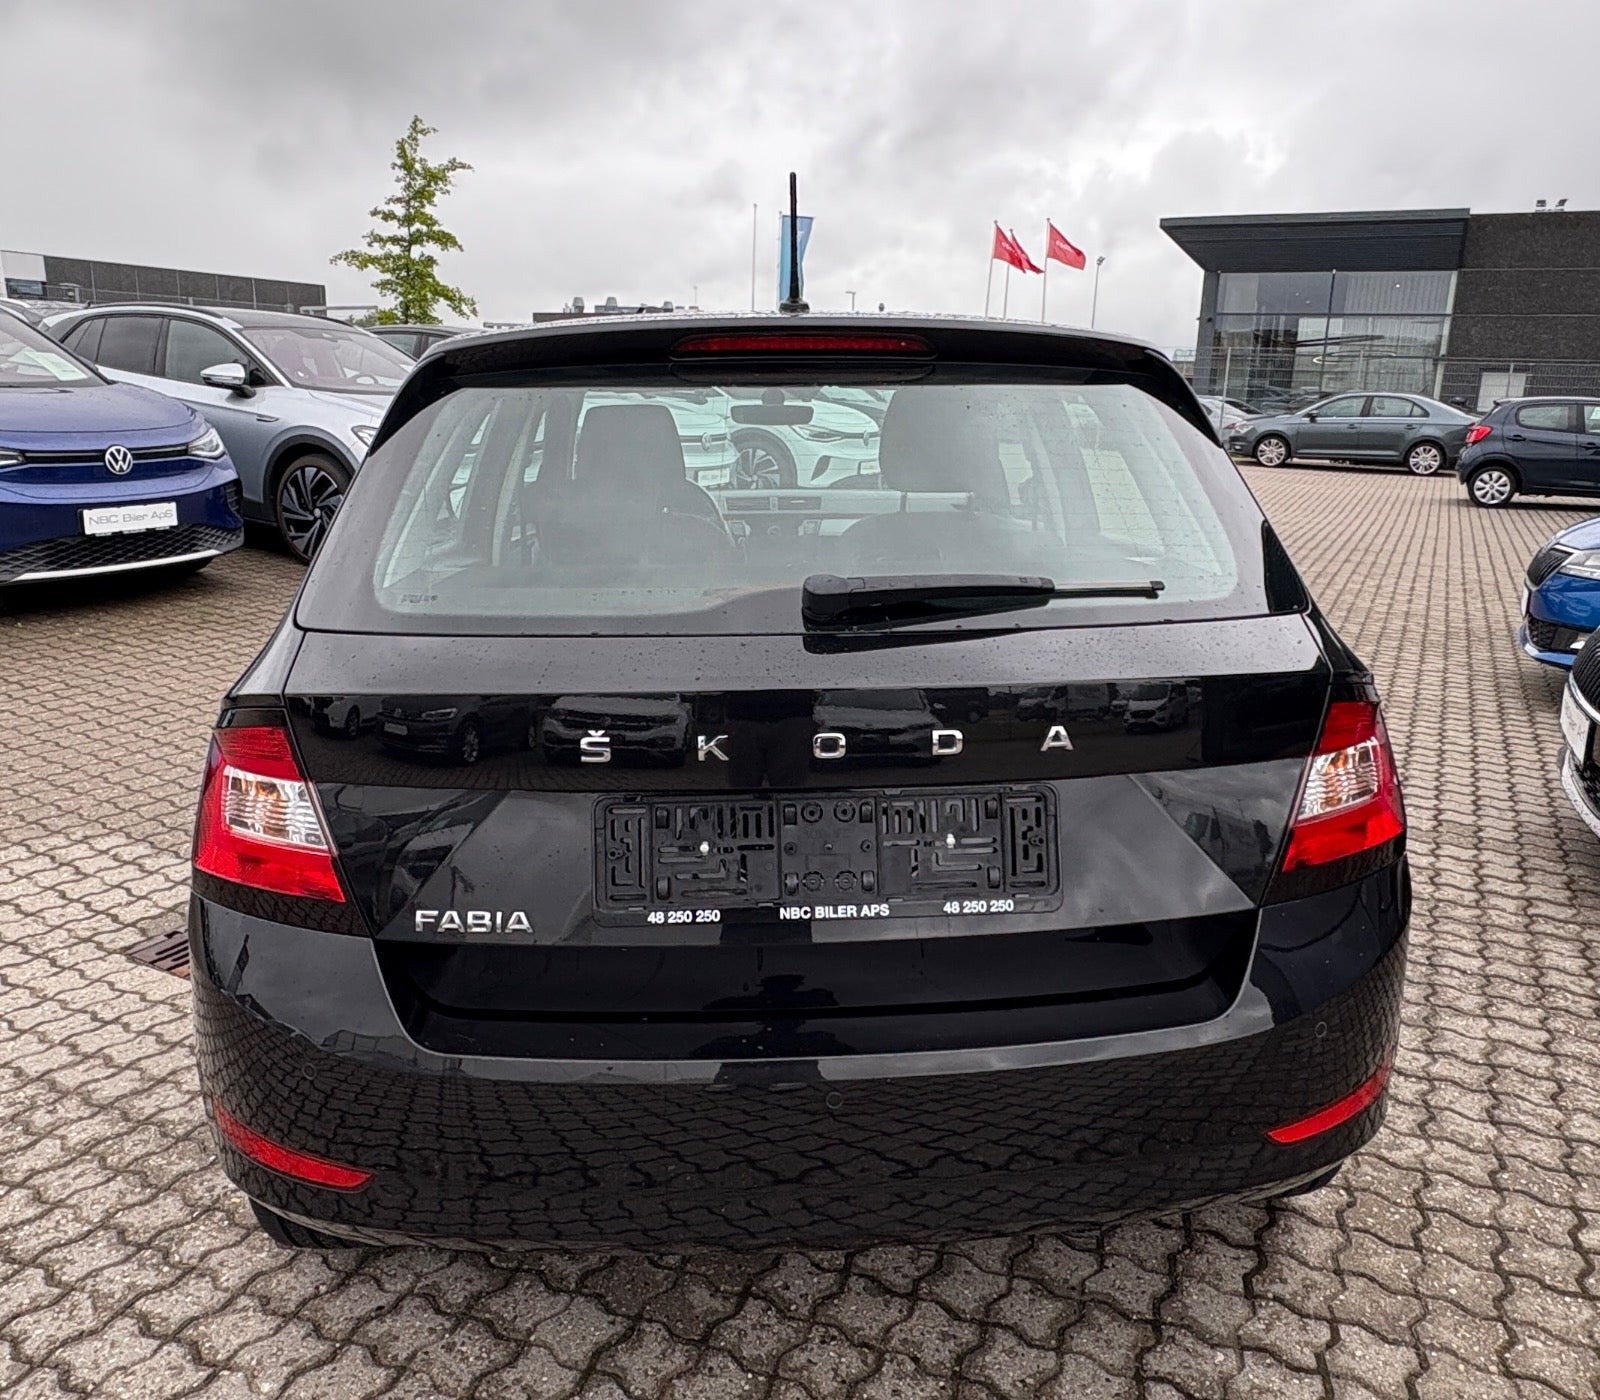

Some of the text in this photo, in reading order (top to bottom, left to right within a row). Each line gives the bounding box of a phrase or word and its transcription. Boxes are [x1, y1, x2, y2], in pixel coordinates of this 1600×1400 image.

[89, 514, 119, 525] NBC
[151, 509, 174, 521] ApS
[579, 725, 1074, 763] ŠKODA
[779, 904, 890, 920] NBC BILER APS
[943, 899, 1015, 914] 48 250 250
[415, 909, 534, 933] FABIA
[647, 909, 721, 924] 48 250 250
